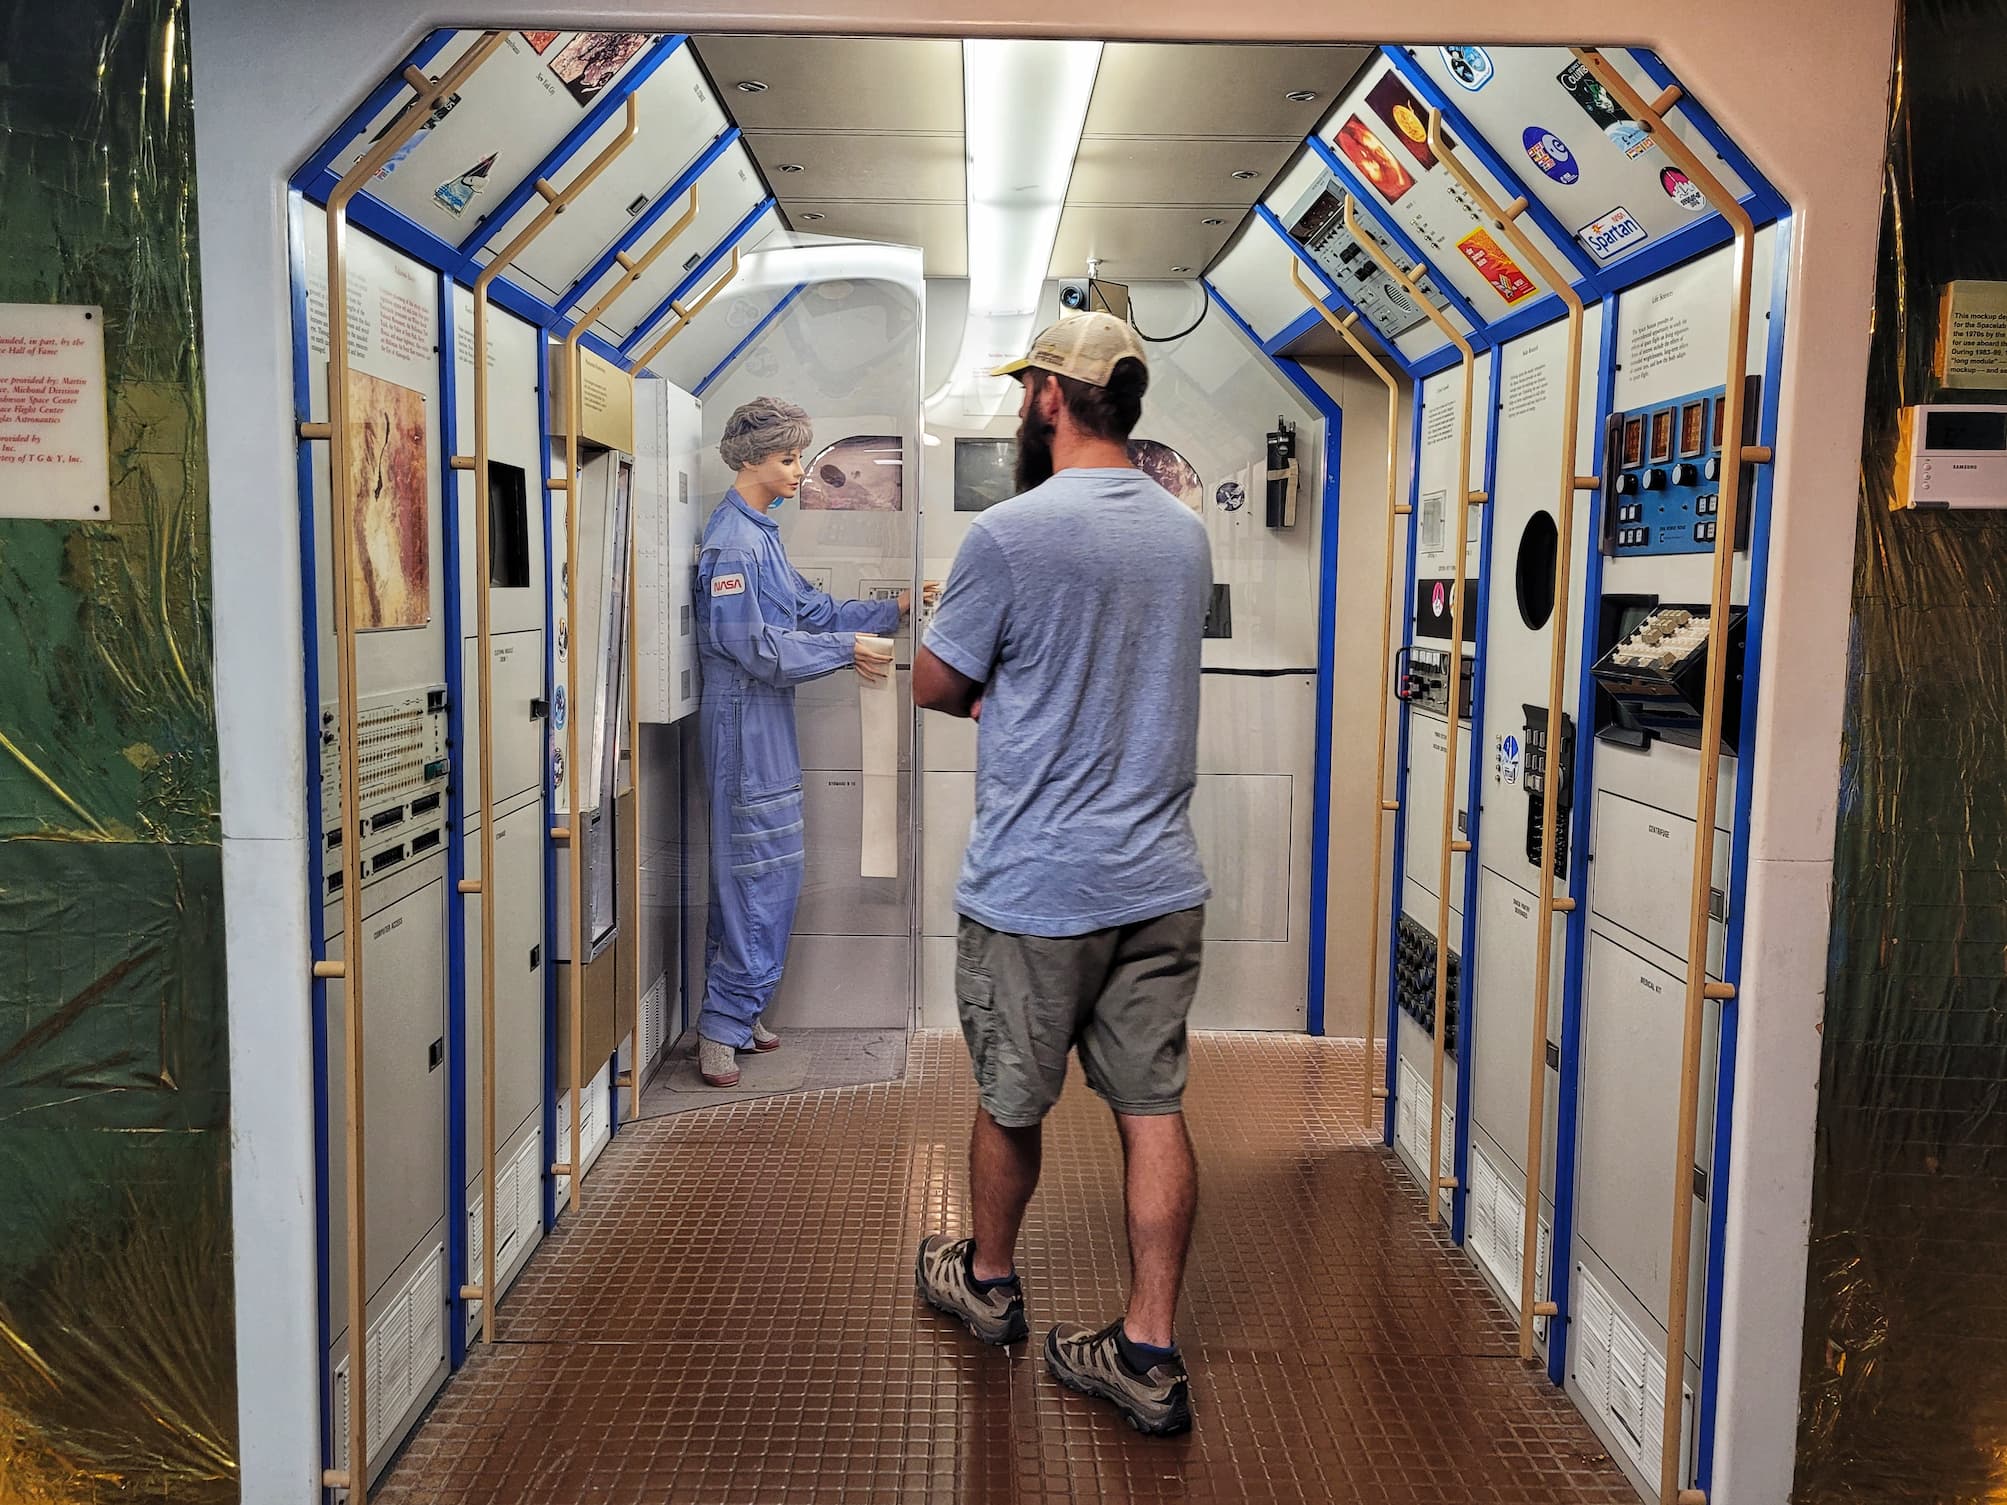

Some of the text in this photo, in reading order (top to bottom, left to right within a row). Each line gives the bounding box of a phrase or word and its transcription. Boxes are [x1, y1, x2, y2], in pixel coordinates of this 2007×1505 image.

[1560, 64, 1588, 91] COLUMB
[1588, 219, 1637, 252] Spartan
[0, 336, 26, 345] unded,
[61, 338, 70, 346] by
[72, 338, 84, 346] the
[27, 347, 36, 356] of
[29, 395, 50, 404] Space
[14, 405, 36, 414] Flight
[16, 415, 60, 424] Astronautics
[32, 435, 40, 444] by
[18, 455, 26, 464] of
[714, 579, 742, 592] NASA
